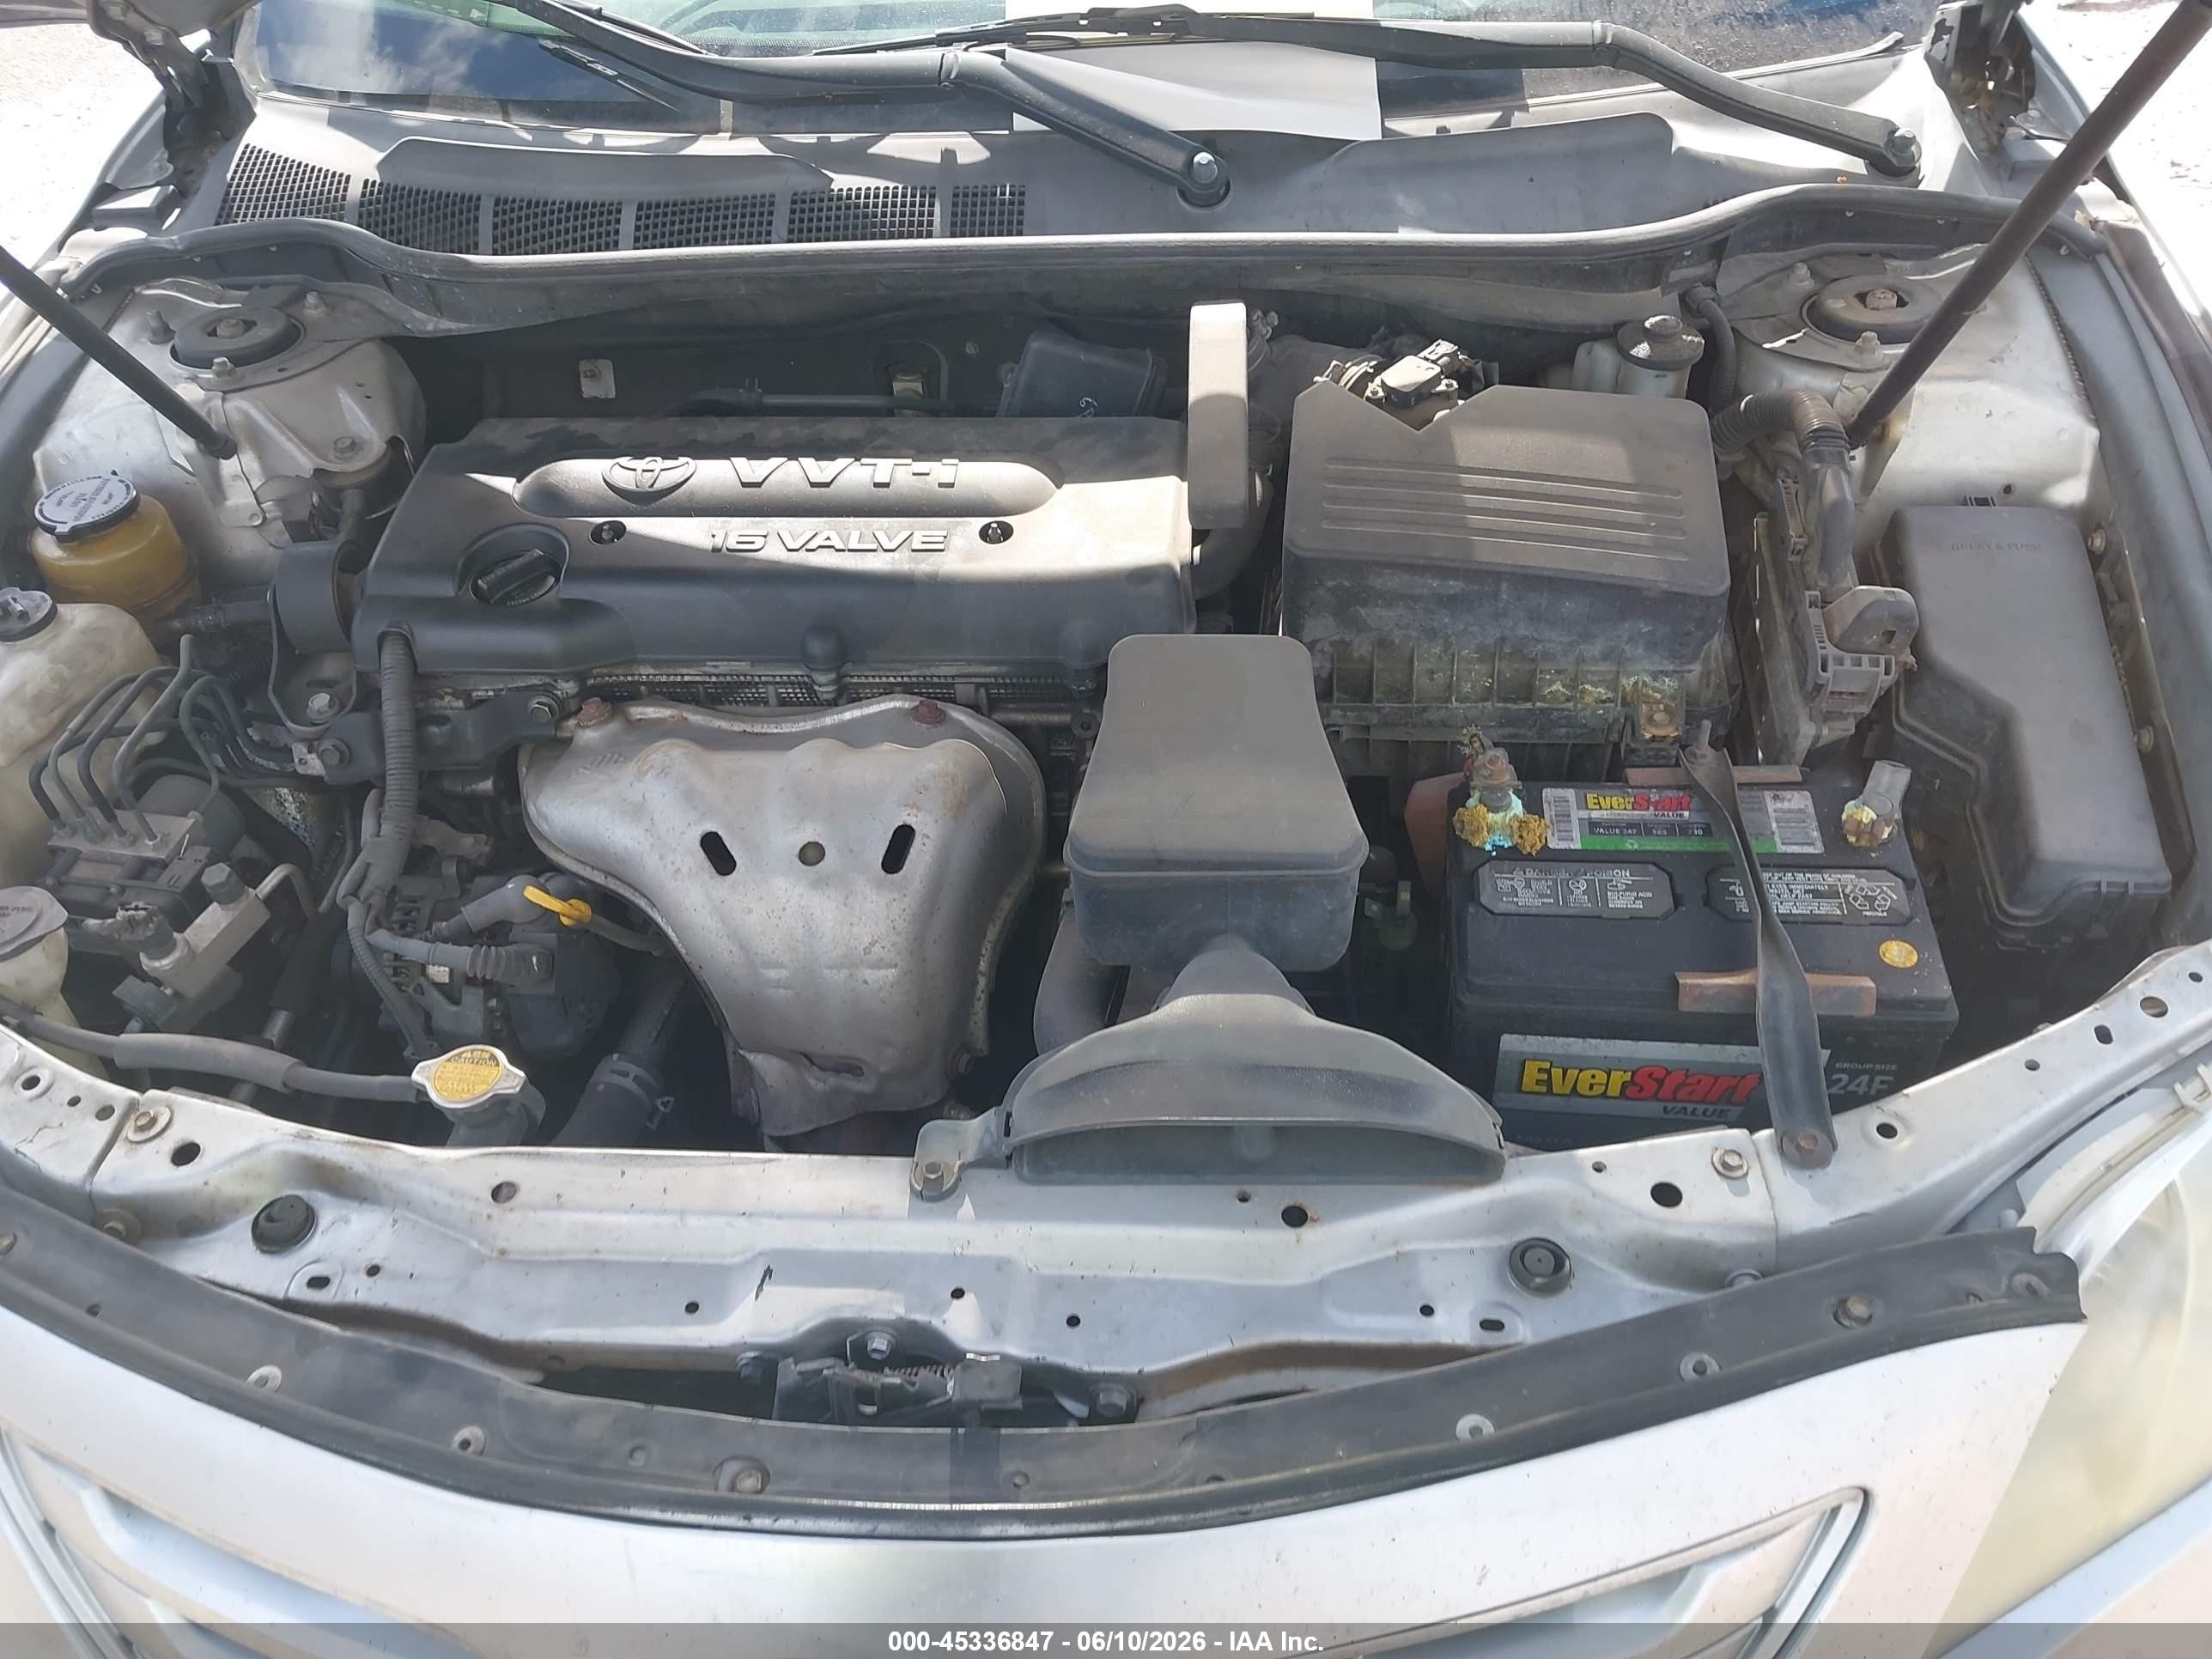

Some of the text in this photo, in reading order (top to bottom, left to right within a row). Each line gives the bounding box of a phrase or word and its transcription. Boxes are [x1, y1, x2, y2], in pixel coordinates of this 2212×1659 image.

[710, 529, 949, 552] 16 VALVE
[1593, 827, 1621, 836] VALUE
[451, 1056, 497, 1066] CAUTION
[1834, 1060, 1898, 1072] GROUP SIZE
[1520, 1058, 1764, 1105] EverStart
[1827, 1072, 1894, 1097] 24F
[1662, 1104, 1733, 1117] VALUE
